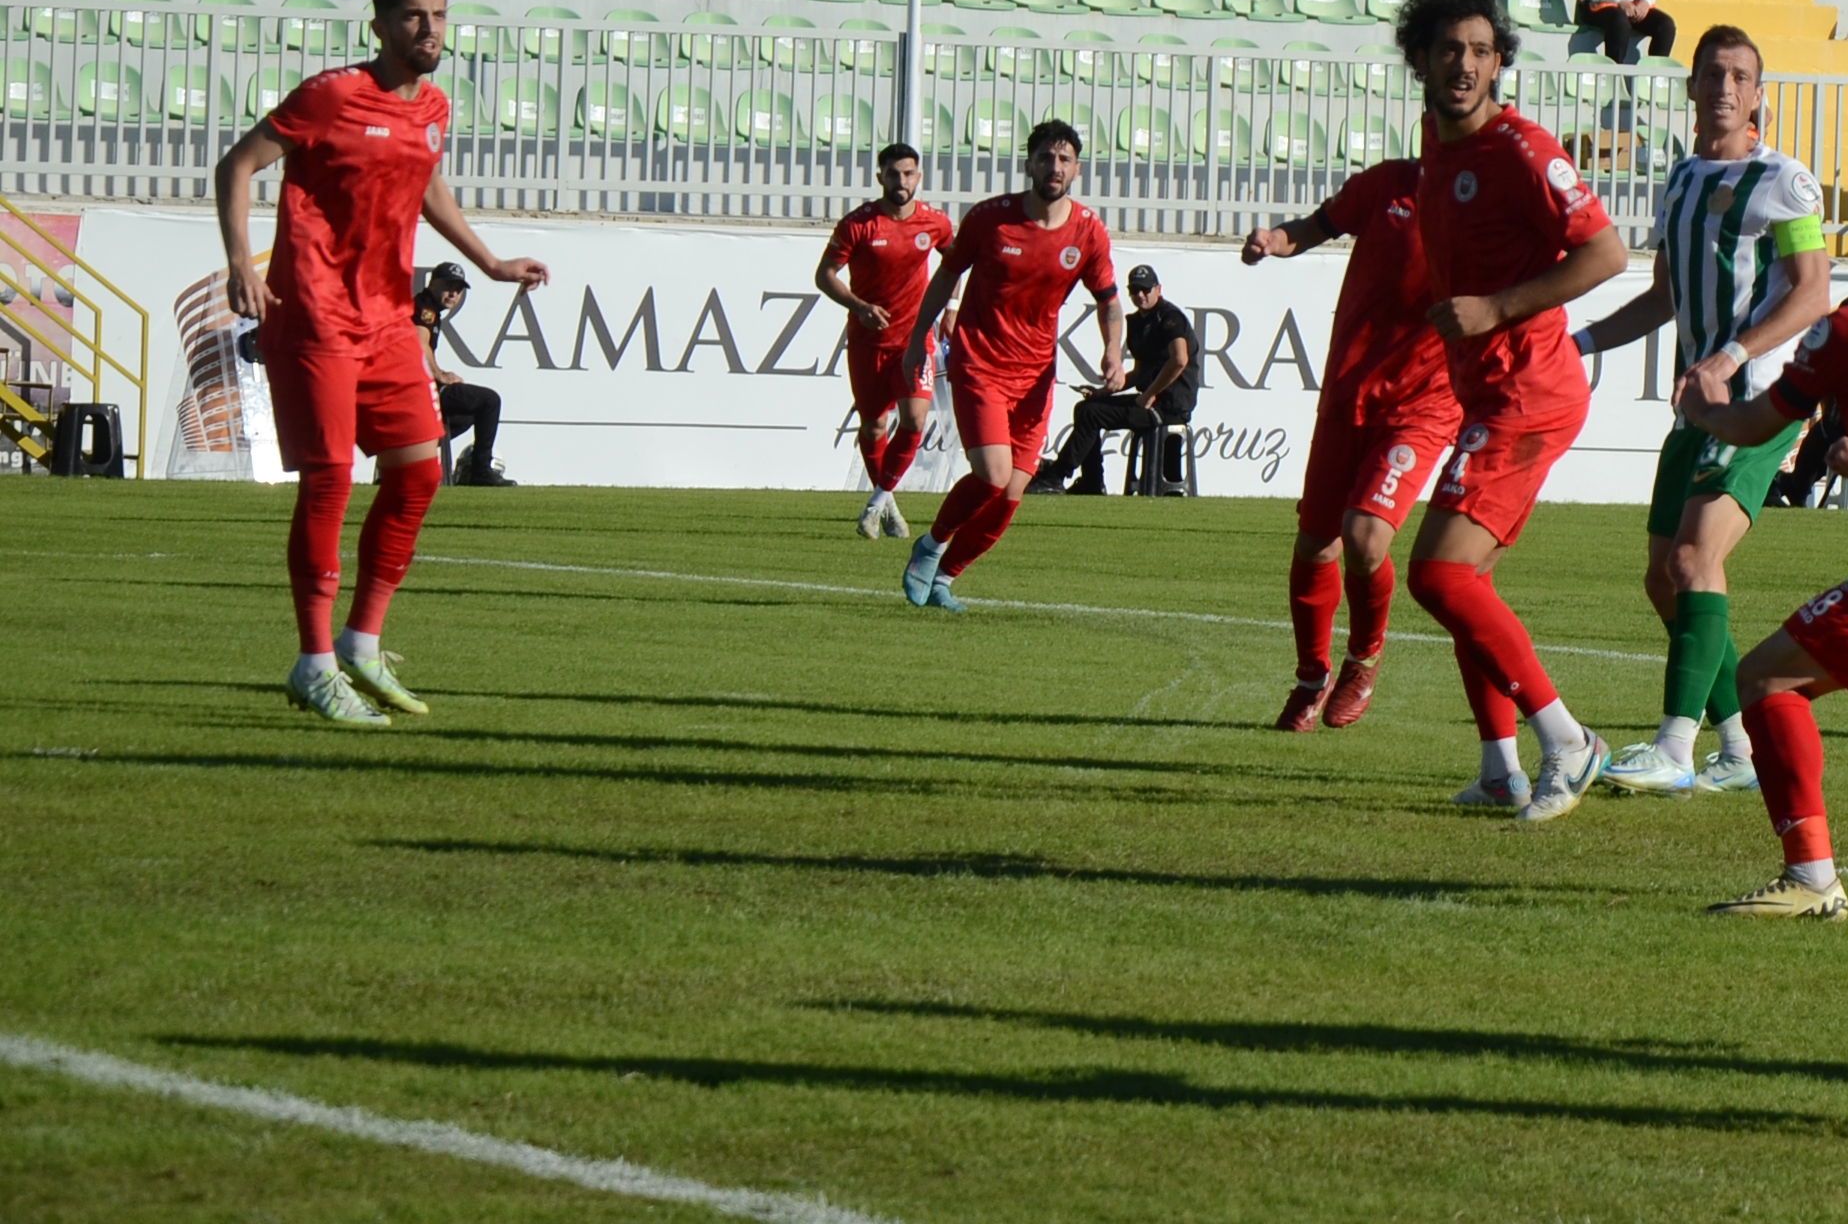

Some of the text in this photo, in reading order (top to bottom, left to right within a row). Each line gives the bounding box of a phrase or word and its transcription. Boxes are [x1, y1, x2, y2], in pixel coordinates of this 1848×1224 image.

[1387, 204, 1411, 219] JAKO
[1001, 246, 1022, 256] JAKO
[1449, 451, 1470, 482] 4
[1381, 469, 1402, 496] 5
[1442, 482, 1466, 496] JAKO
[1372, 492, 1396, 510] JAKO
